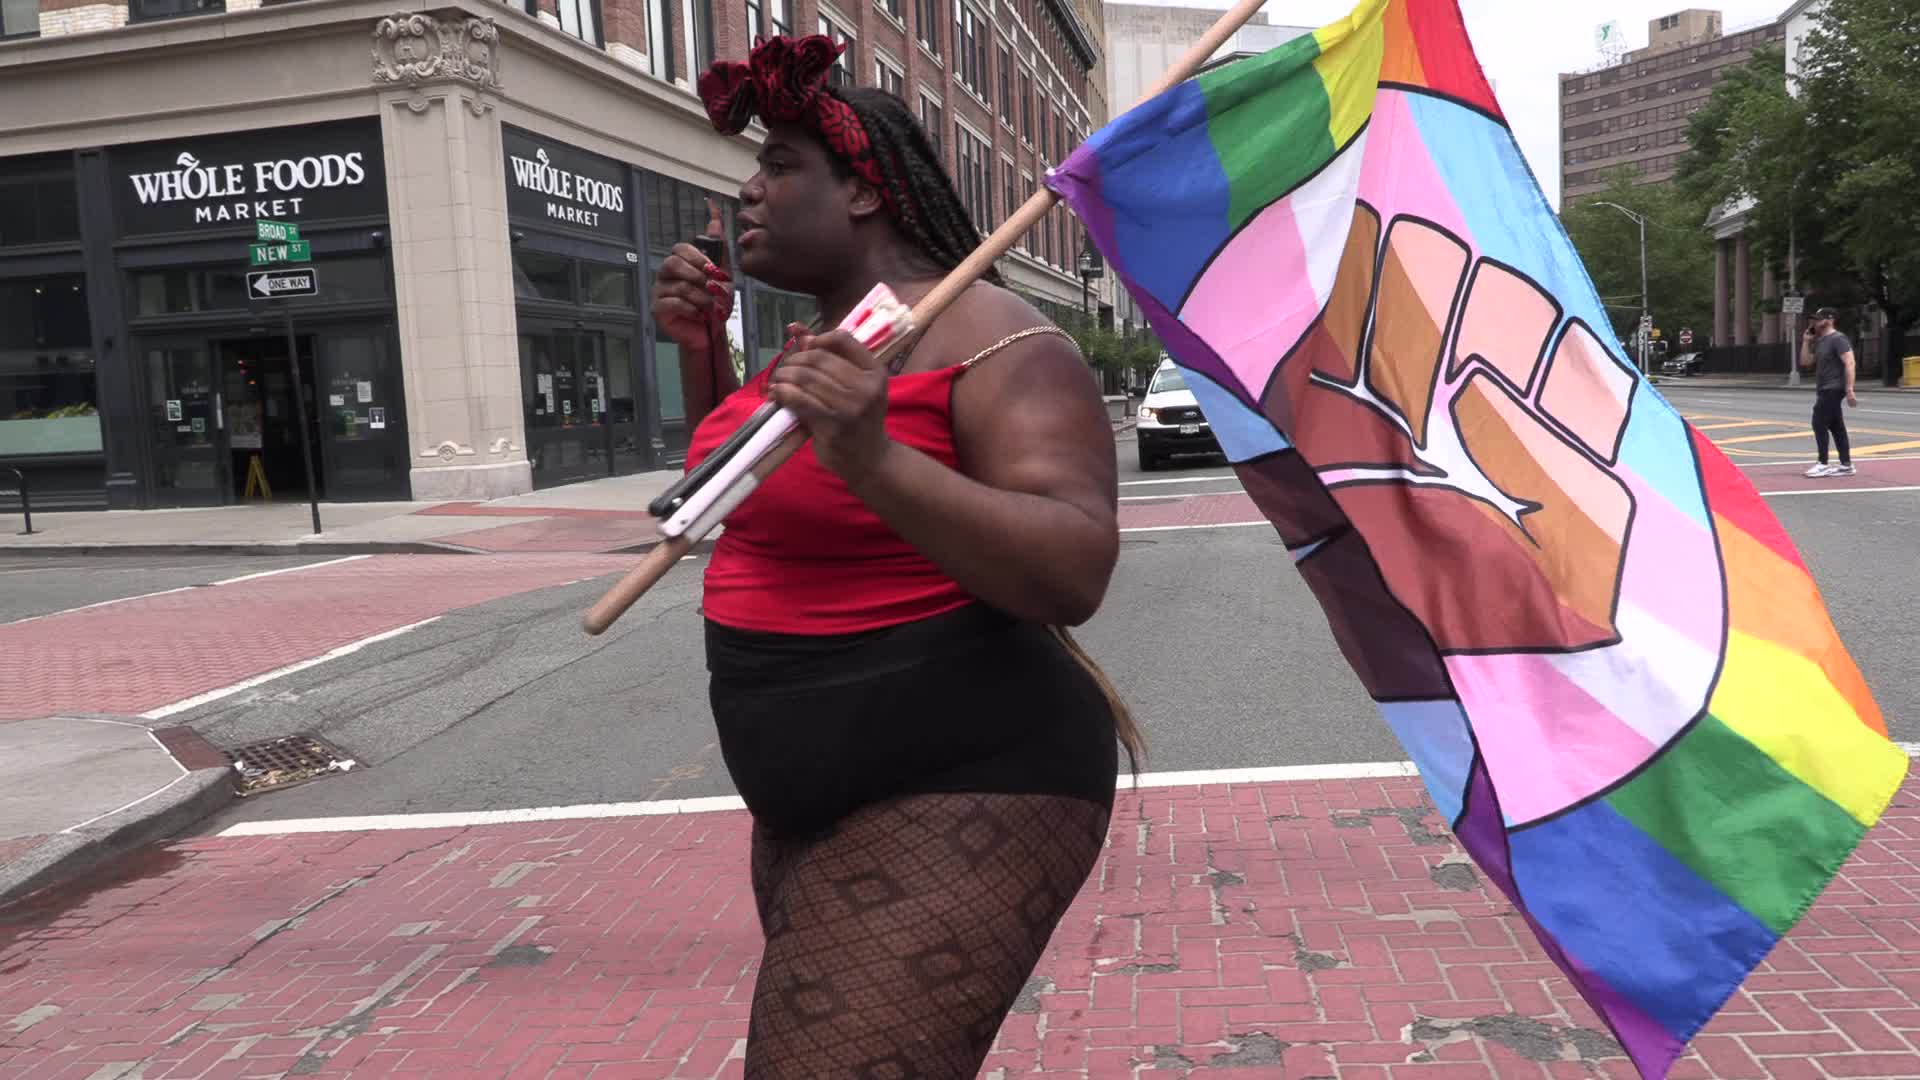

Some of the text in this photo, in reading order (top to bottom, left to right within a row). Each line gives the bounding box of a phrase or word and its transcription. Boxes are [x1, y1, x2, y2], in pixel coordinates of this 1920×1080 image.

[130, 152, 365, 204] WHOLE FOODS
[510, 148, 624, 213] WHOLE FOODS
[195, 198, 303, 223] MARKET
[547, 202, 599, 226] MARKET
[258, 223, 287, 240] BROAD
[256, 243, 303, 262] NEW ST
[268, 277, 308, 290] ONE WAY
